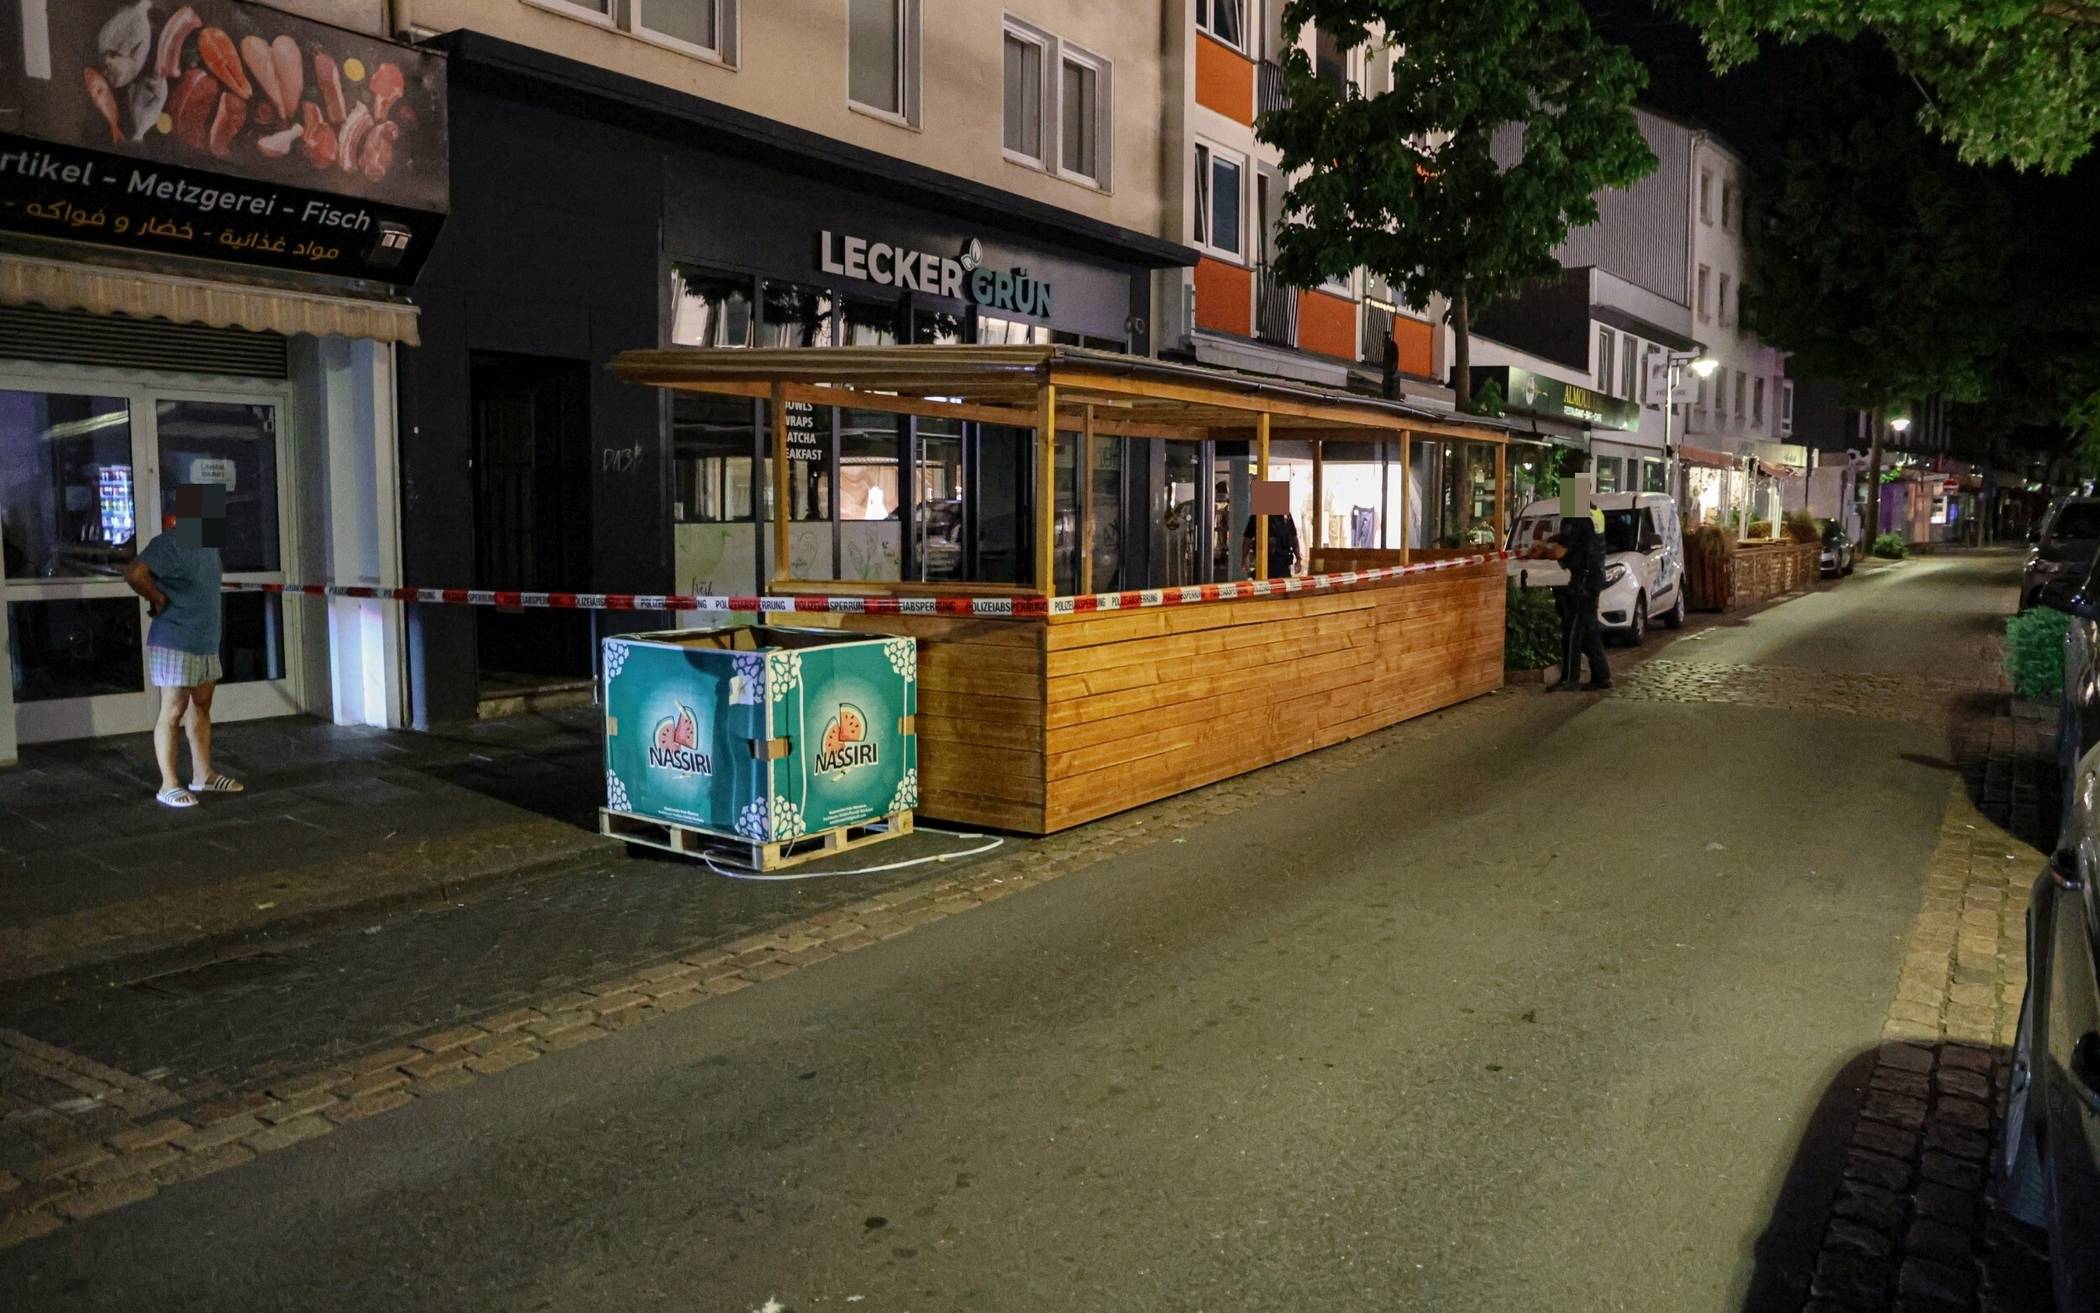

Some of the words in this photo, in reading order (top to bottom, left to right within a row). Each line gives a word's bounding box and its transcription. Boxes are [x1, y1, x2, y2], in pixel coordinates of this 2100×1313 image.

[0, 151, 93, 187] rtikel
[127, 170, 277, 217] Metzgerei
[301, 201, 371, 232] Fisch
[26, 199, 107, 228] فواكه
[114, 215, 130, 233] و
[137, 216, 195, 240] خضار
[292, 240, 341, 261] مواد
[821, 230, 962, 299] LECKER
[971, 267, 1056, 317] GRÜN
[787, 432, 817, 444] ATCHA
[786, 448, 823, 461] EAKFAST
[649, 747, 712, 774] NASSIRI
[815, 743, 877, 773] NASSIRI
